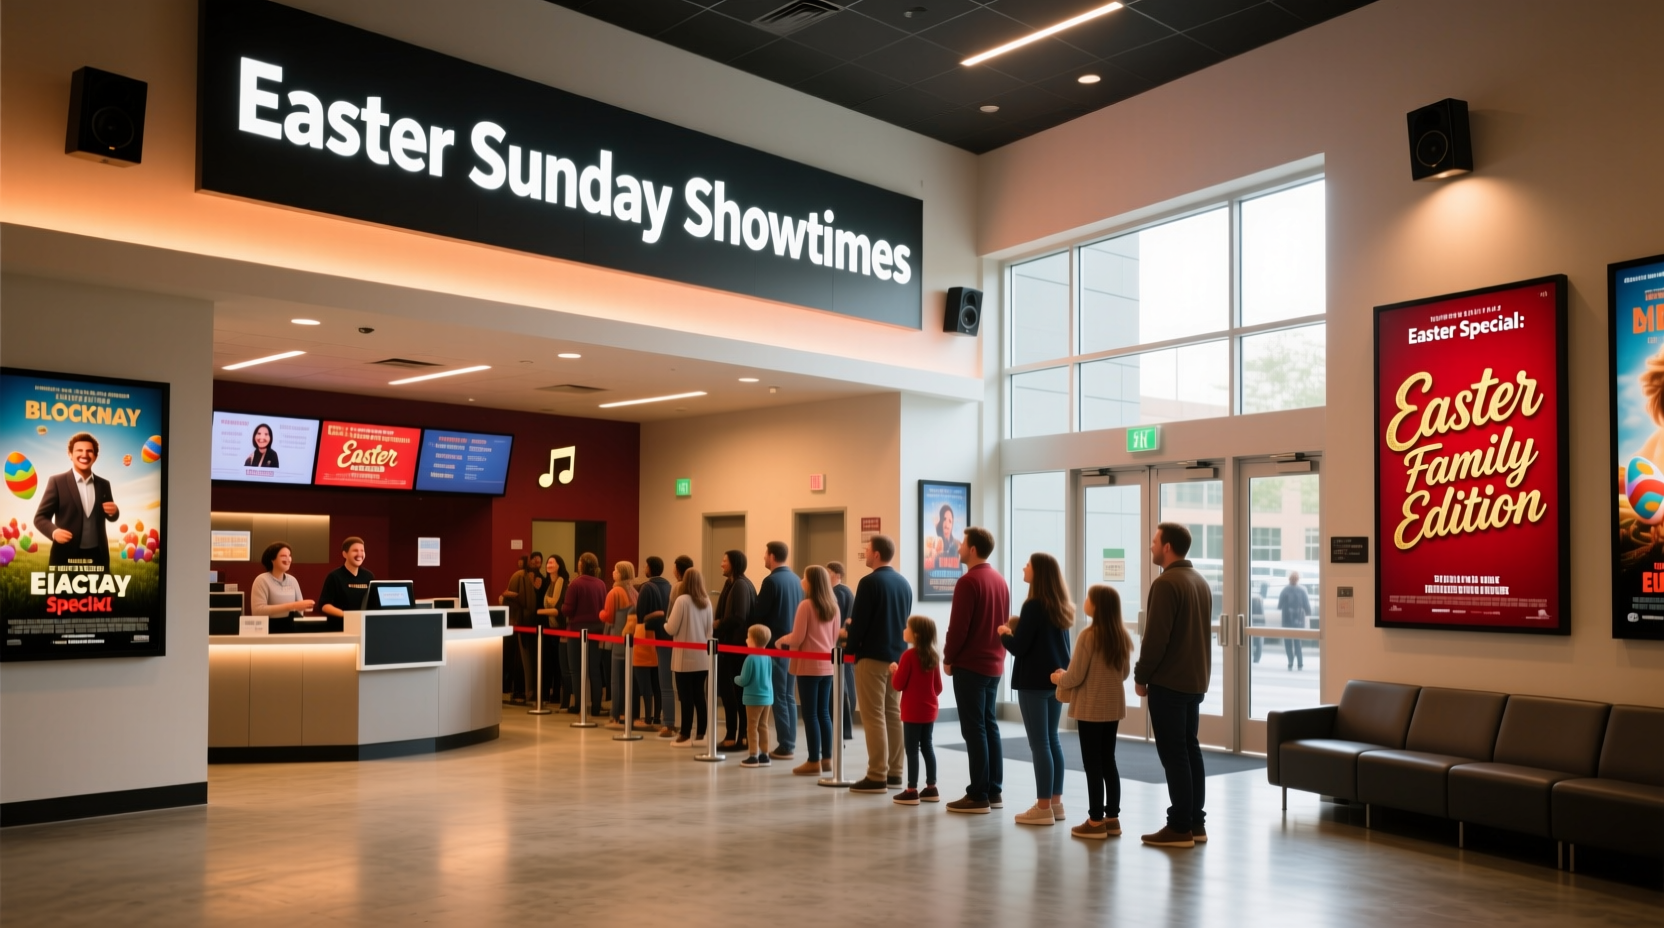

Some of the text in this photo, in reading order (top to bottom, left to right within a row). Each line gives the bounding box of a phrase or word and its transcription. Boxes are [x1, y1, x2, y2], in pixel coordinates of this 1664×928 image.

[239, 57, 911, 284] Easter Sunday Showtimes
[1408, 325, 1456, 345] Easter
[1459, 311, 1525, 340] Special:
[25, 400, 141, 427] BLOCKNAY
[1386, 367, 1544, 452] Easter
[337, 439, 398, 468] Easter
[1403, 426, 1539, 493] Family
[1394, 484, 1547, 550] Edition
